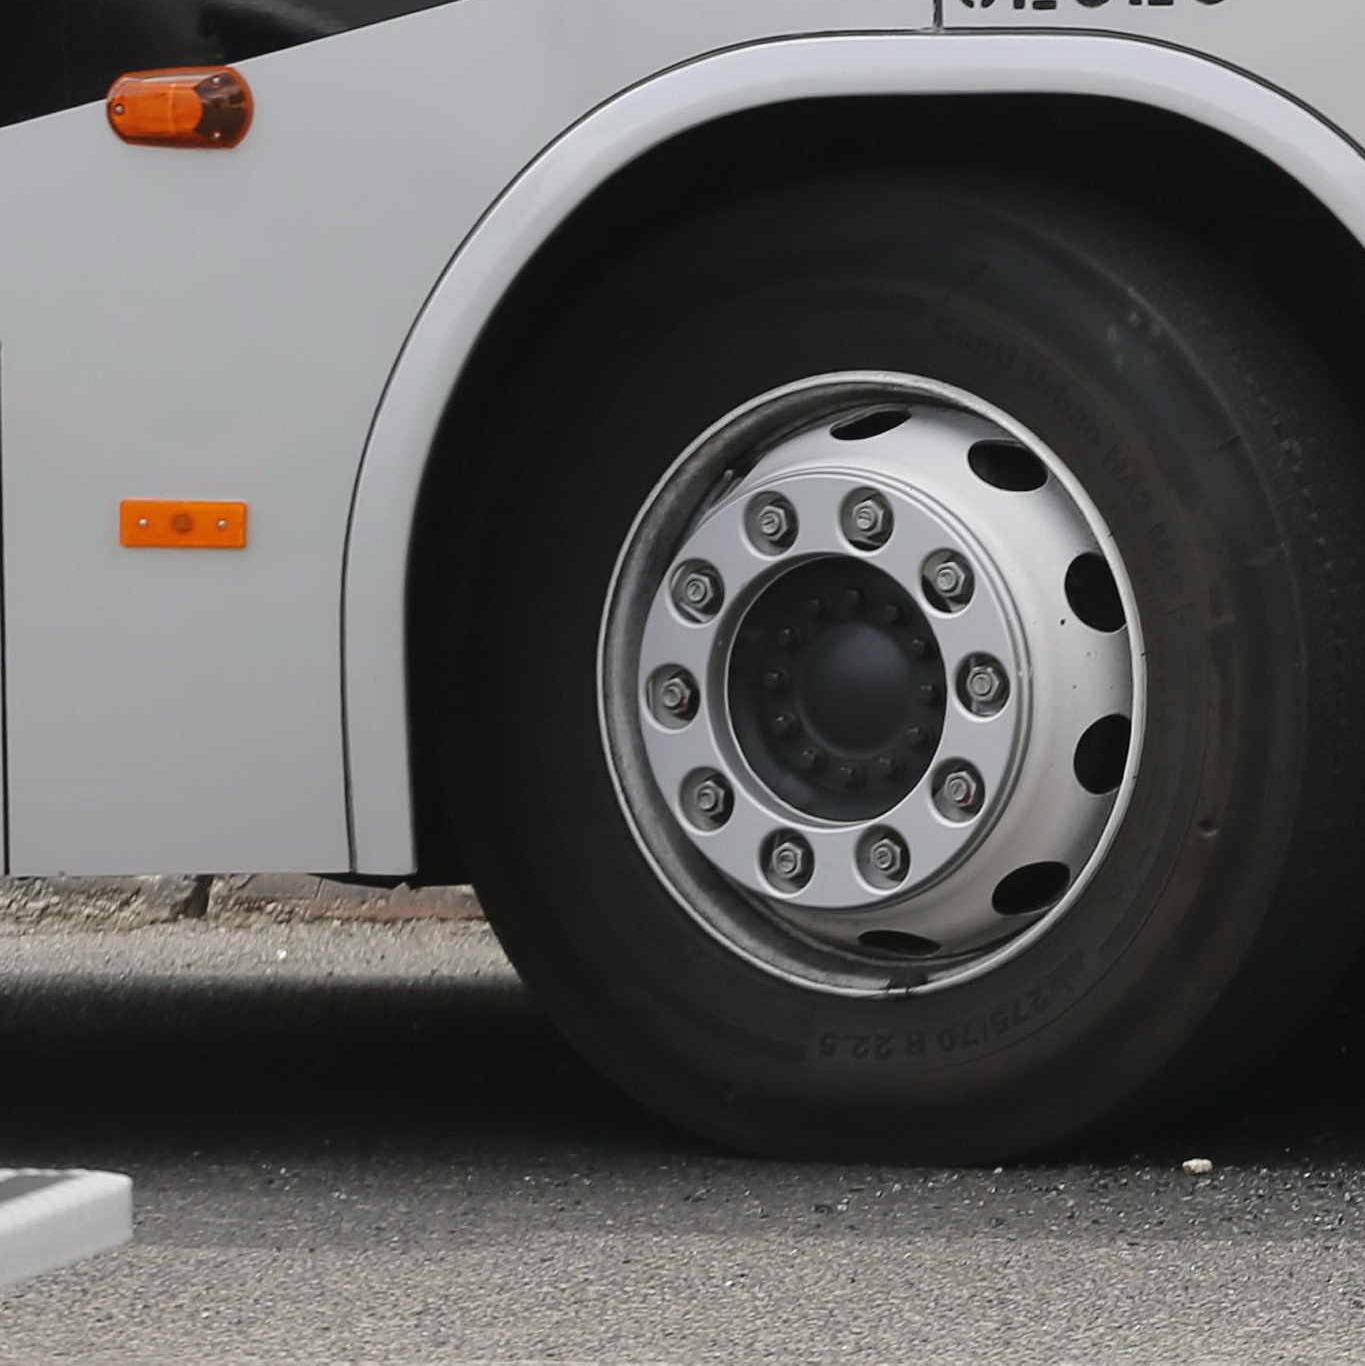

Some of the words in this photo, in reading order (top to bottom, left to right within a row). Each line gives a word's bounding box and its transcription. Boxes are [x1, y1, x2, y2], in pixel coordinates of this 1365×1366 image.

[937, 985, 1050, 1053] 275/70
[818, 1032, 895, 1062] 22.5
[904, 1031, 928, 1057] R
